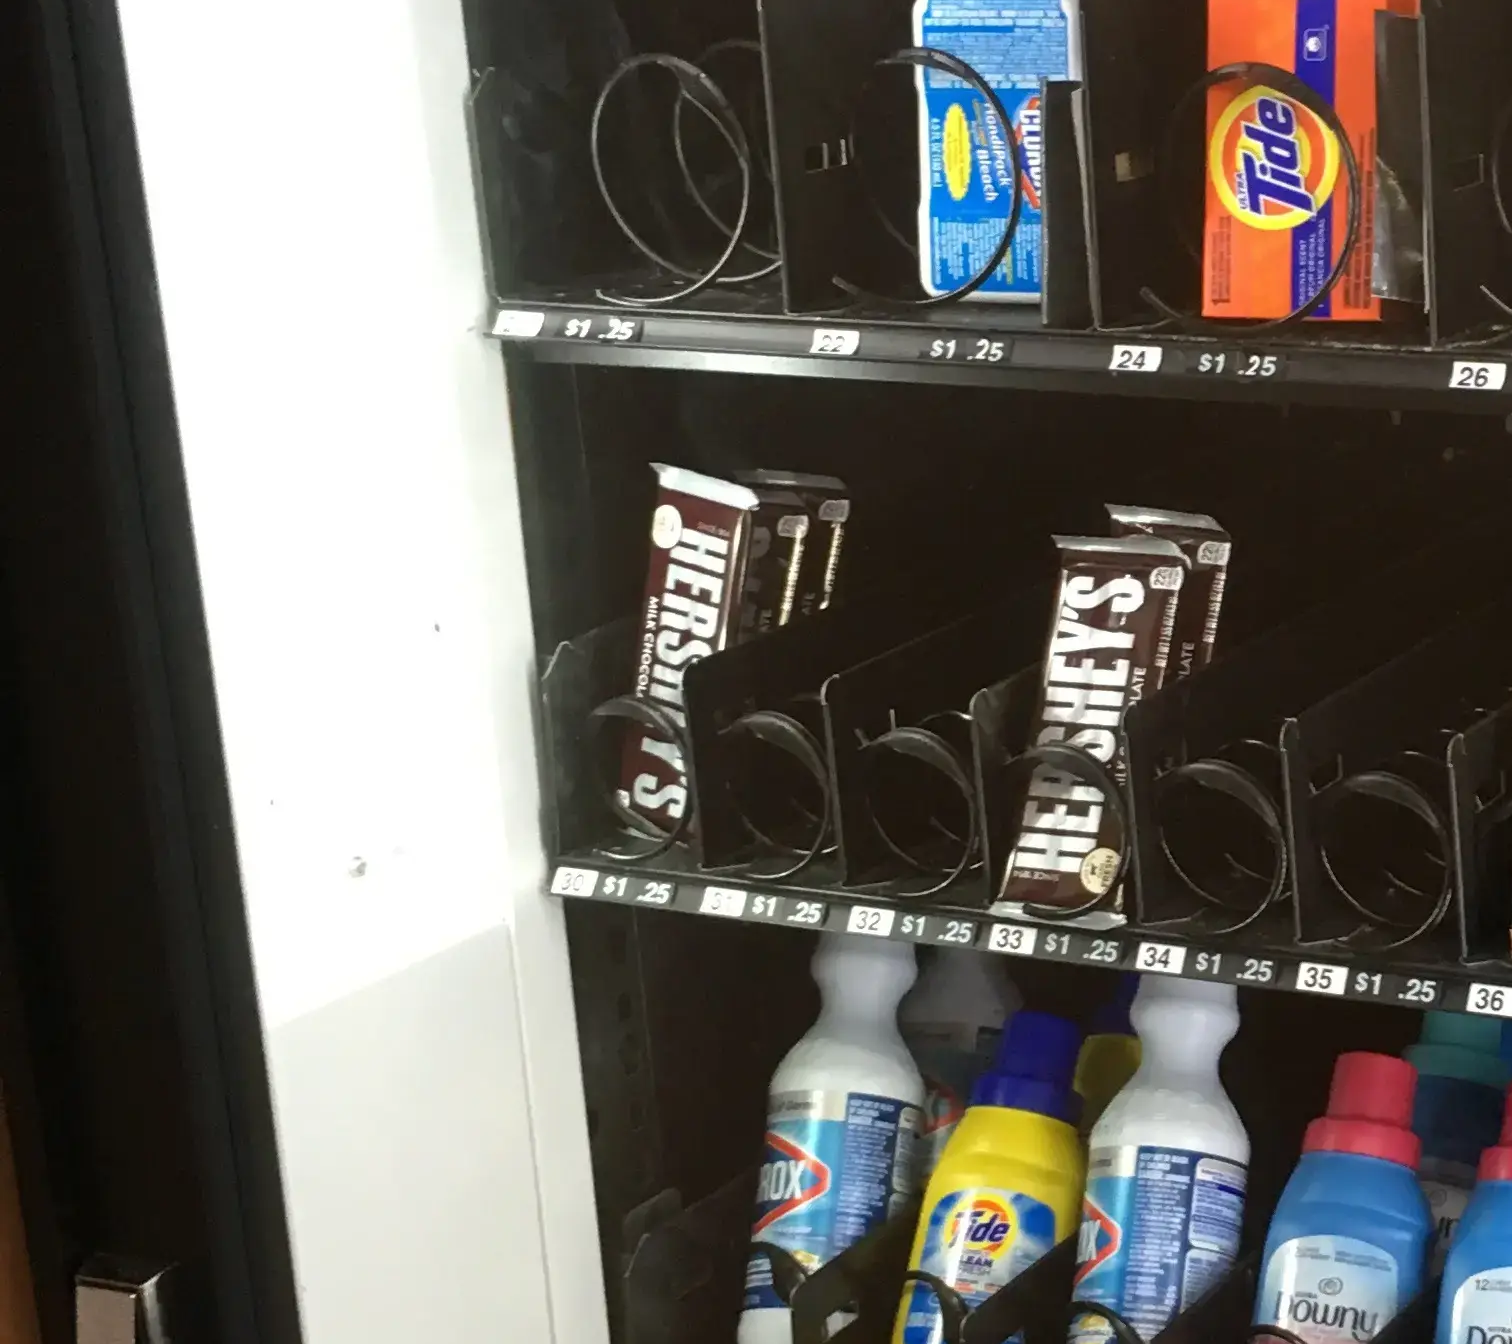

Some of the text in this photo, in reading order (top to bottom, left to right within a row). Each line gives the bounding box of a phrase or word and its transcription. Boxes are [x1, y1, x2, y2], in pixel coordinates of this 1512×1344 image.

[1241, 95, 1318, 217] Tide
[565, 319, 589, 338] $1
[598, 320, 635, 340] .25
[930, 339, 956, 359] $1
[967, 341, 1004, 362] .25
[1118, 348, 1277, 377] 24 $1 .25
[1458, 365, 1489, 388] 26
[646, 595, 660, 630] MILK
[603, 876, 627, 897] $1
[636, 882, 672, 904] .25
[752, 896, 776, 919] $1
[787, 902, 823, 925] .25
[856, 911, 973, 944] 32 $1 .25
[996, 927, 1119, 963] 33 $1 .25
[1143, 947, 1273, 983] 34 $1 .25
[1303, 966, 1437, 1003] 35 $1 .25
[1475, 987, 1505, 1012] 36
[959, 1254, 995, 1268] LEAN
